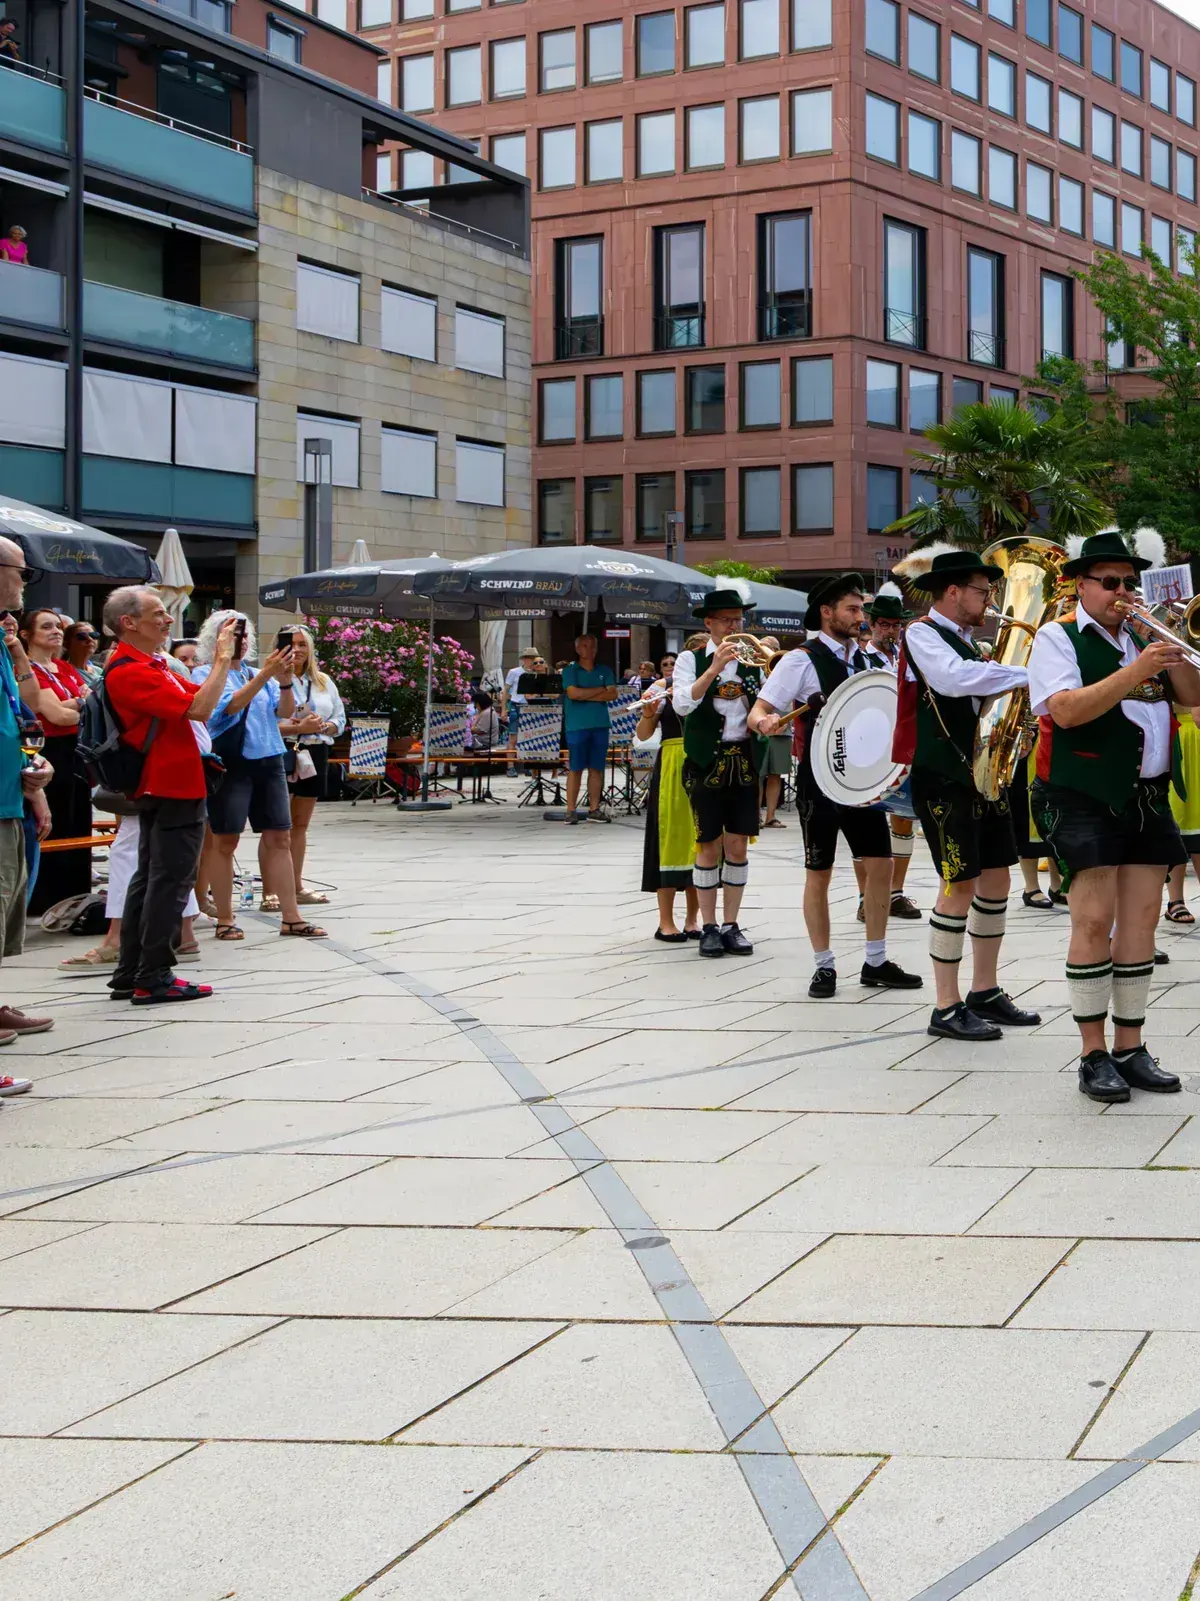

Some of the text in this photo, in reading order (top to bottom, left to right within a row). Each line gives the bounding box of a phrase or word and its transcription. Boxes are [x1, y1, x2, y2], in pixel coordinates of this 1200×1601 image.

[480, 579, 563, 591] SCHWIND BRÄU
[762, 617, 801, 626] SCHWIND
